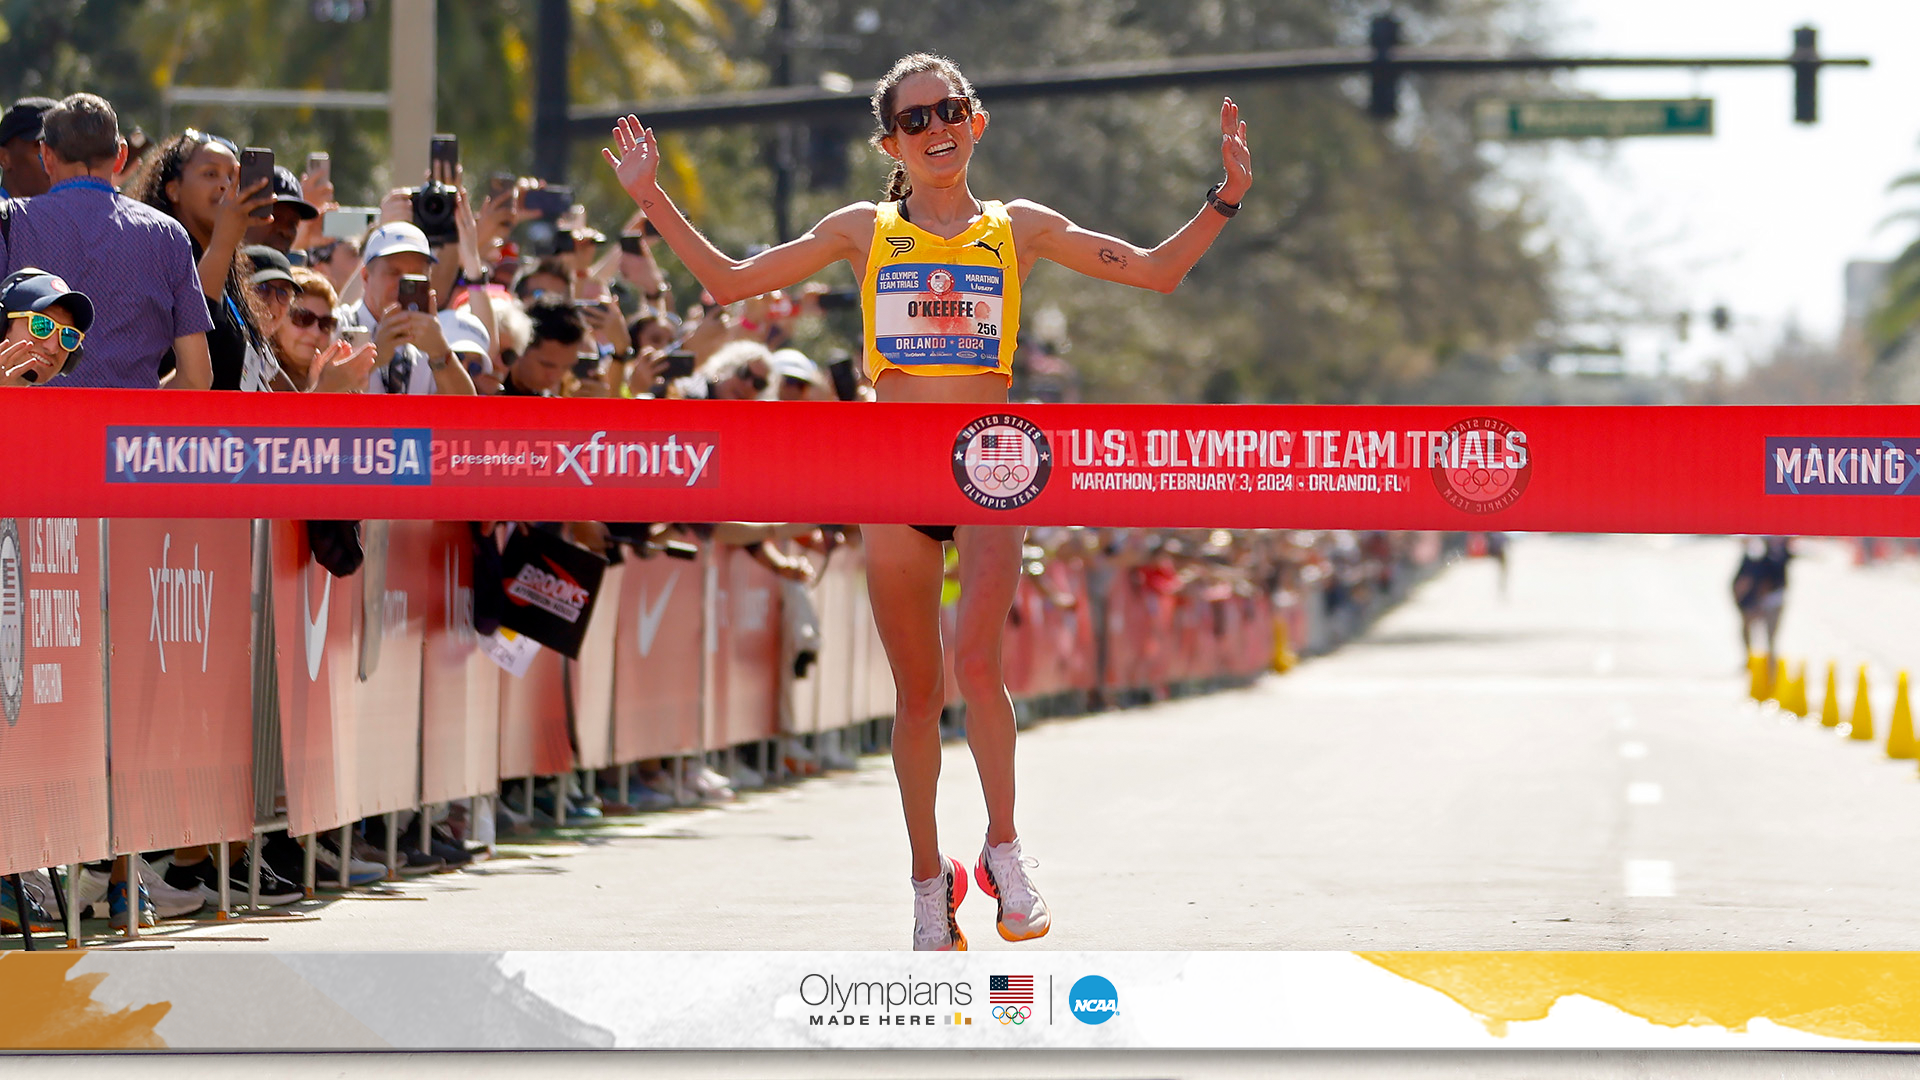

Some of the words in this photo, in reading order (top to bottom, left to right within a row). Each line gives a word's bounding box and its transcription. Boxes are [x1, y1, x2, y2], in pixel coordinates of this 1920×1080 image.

[880, 273, 891, 281] U.S.
[892, 271, 919, 280] OLYMPIC
[880, 281, 896, 290] TEAM
[897, 280, 919, 289] TRIALS
[965, 274, 1000, 284] MARATHON
[908, 301, 974, 317] O'KEEFFE
[977, 322, 997, 336] 256
[896, 338, 946, 350] ORLANDO
[958, 338, 984, 350] 2024
[962, 416, 999, 440] UNITED
[1004, 416, 1041, 440] STATES
[115, 436, 245, 473] MAKING
[253, 437, 341, 474] TEAM
[353, 438, 421, 475] USA
[451, 453, 526, 468] presented
[530, 453, 550, 469] by
[555, 431, 715, 487] xfinity
[1072, 429, 1134, 467] U.S.
[1147, 430, 1291, 467] OLYMPIC
[1302, 431, 1395, 468] TEAM
[1407, 431, 1527, 468] TRIALS
[1776, 447, 1905, 484] MAKING
[963, 483, 1007, 508] OLYMPIC
[1013, 484, 1040, 506] TEAM
[1072, 473, 1156, 492] MARATHON,
[1160, 473, 1236, 491] FEBRUARY
[1239, 474, 1252, 492] 3,
[1257, 473, 1293, 491] 2024
[1309, 474, 1381, 493] ORLANDO,
[1385, 474, 1402, 491] FL
[46, 518, 79, 574] OLYMPIC
[516, 562, 590, 610] BROOKS
[149, 532, 214, 673] xfinity
[30, 589, 53, 647] TEAM
[53, 589, 81, 647] TRIALS
